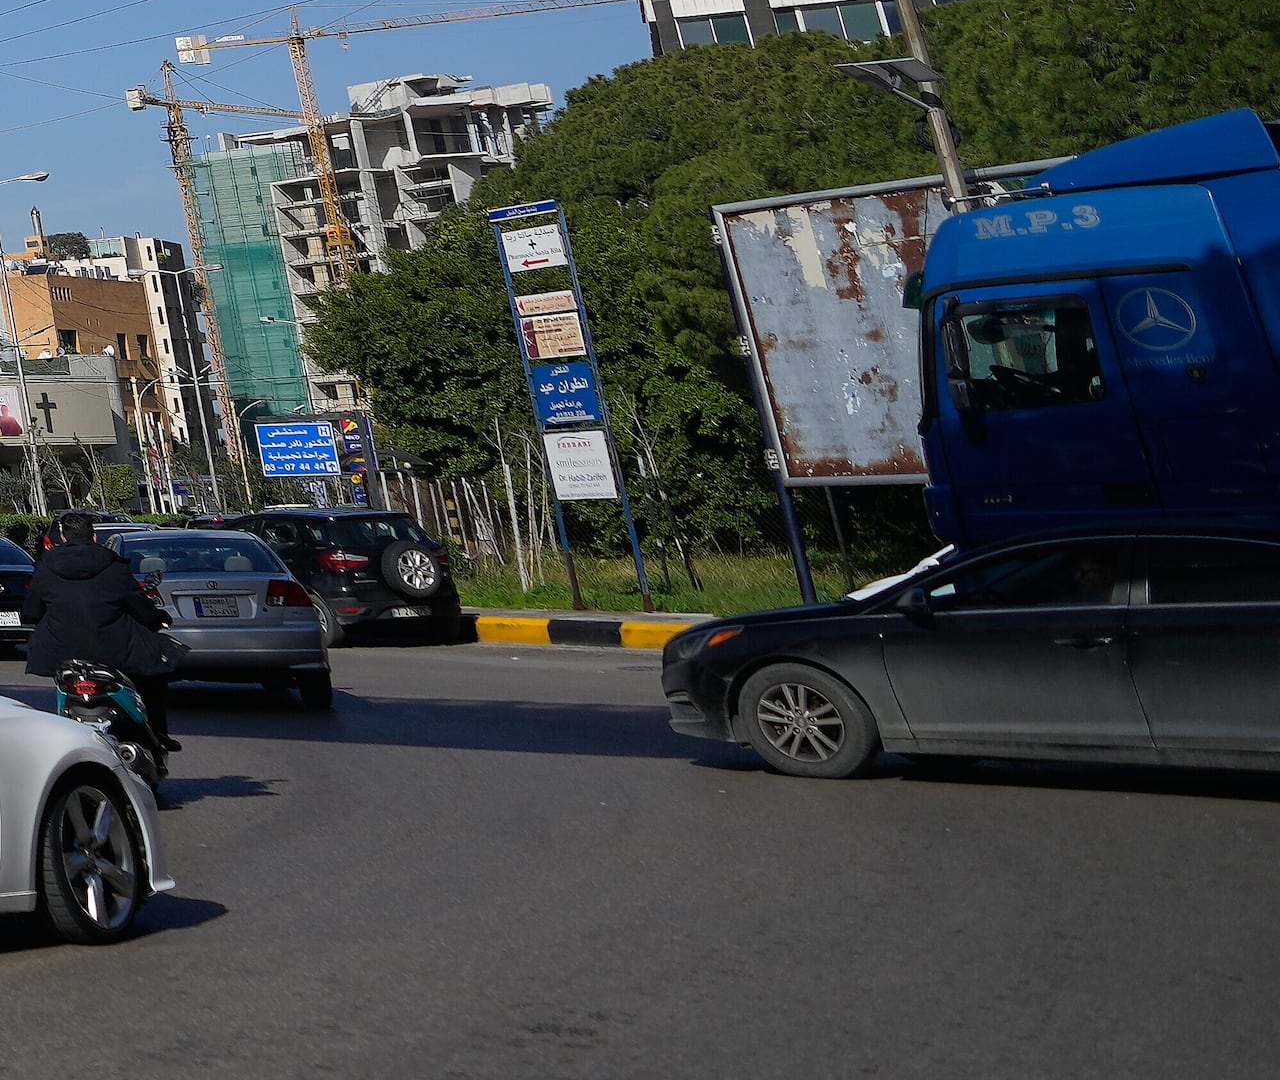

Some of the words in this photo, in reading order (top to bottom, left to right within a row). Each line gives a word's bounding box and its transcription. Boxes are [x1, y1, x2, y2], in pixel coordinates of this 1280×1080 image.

[974, 205, 1100, 239] M.P.3
[264, 463, 276, 472] 03
[284, 463, 296, 472] 07
[299, 463, 310, 471] 44
[314, 462, 325, 471] 44
